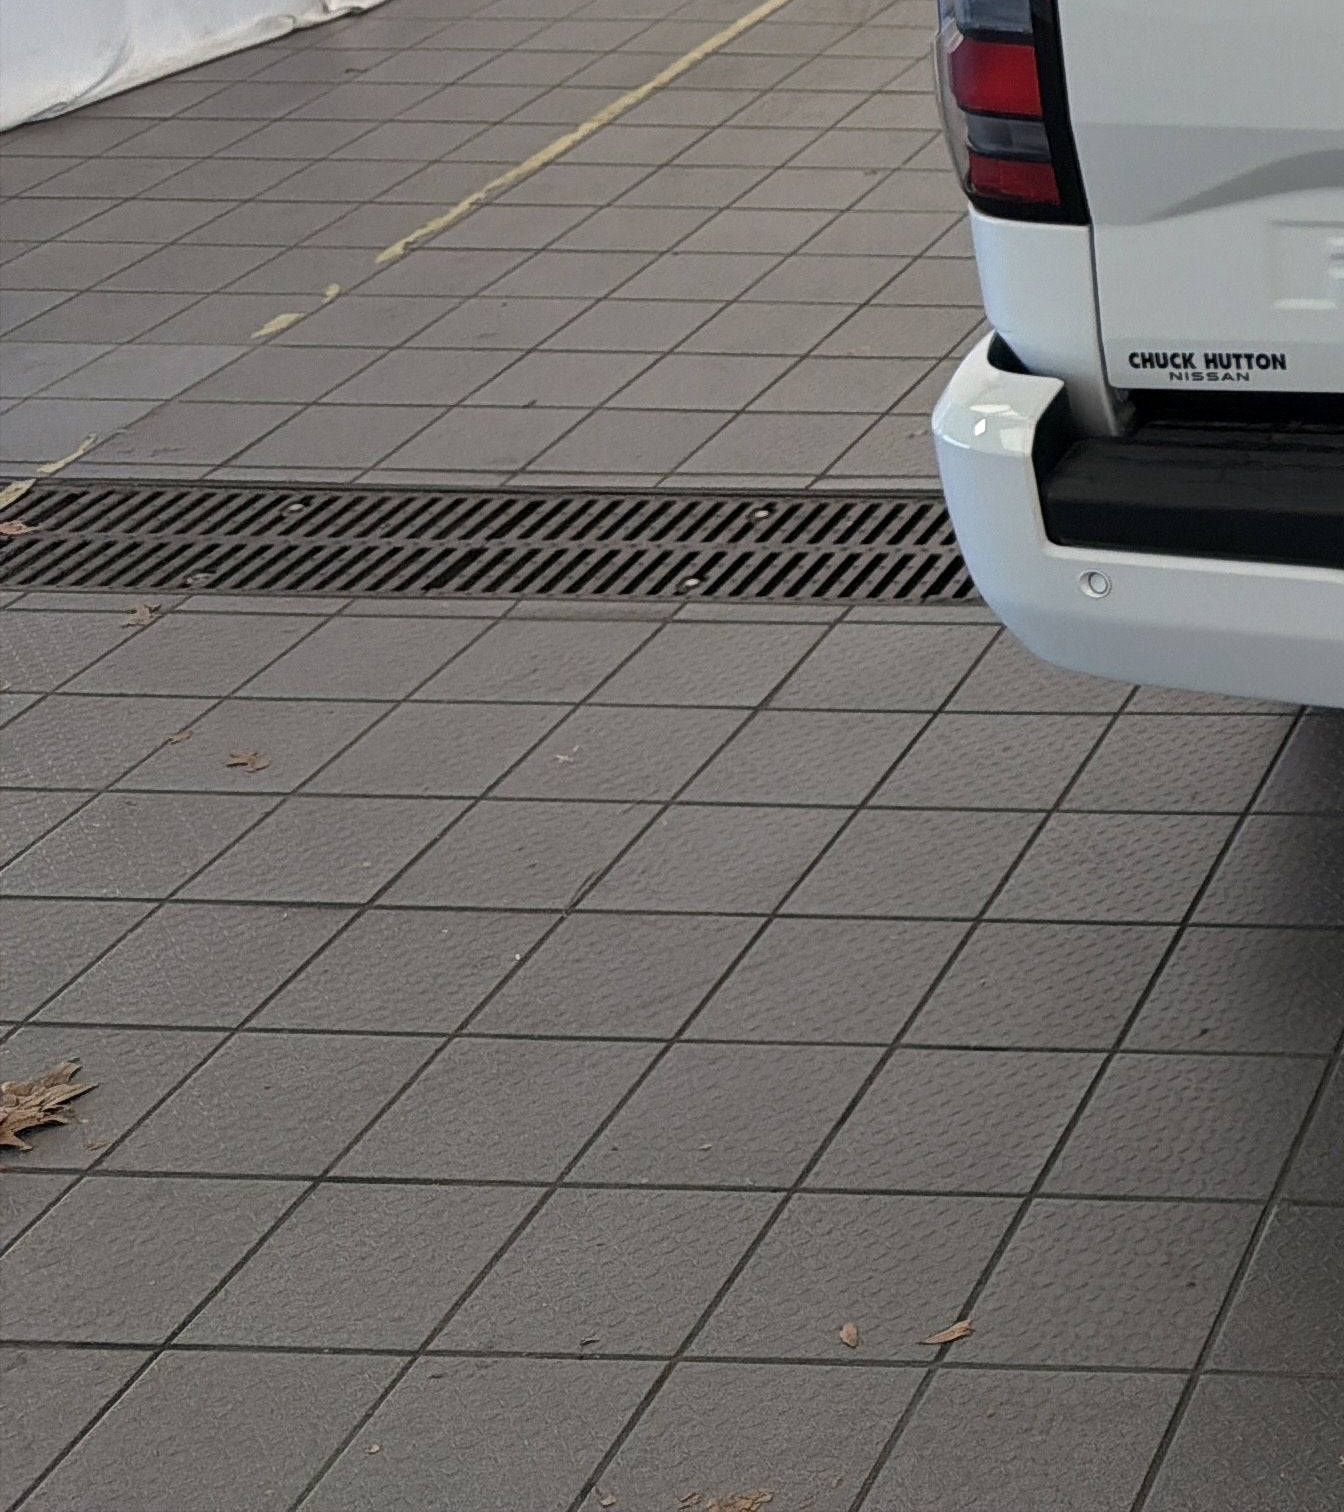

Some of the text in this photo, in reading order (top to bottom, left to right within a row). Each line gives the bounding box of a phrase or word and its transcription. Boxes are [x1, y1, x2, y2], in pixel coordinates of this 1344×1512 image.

[1128, 351, 1288, 371] CHUCK HUTTON
[1169, 371, 1250, 382] NISSAN
